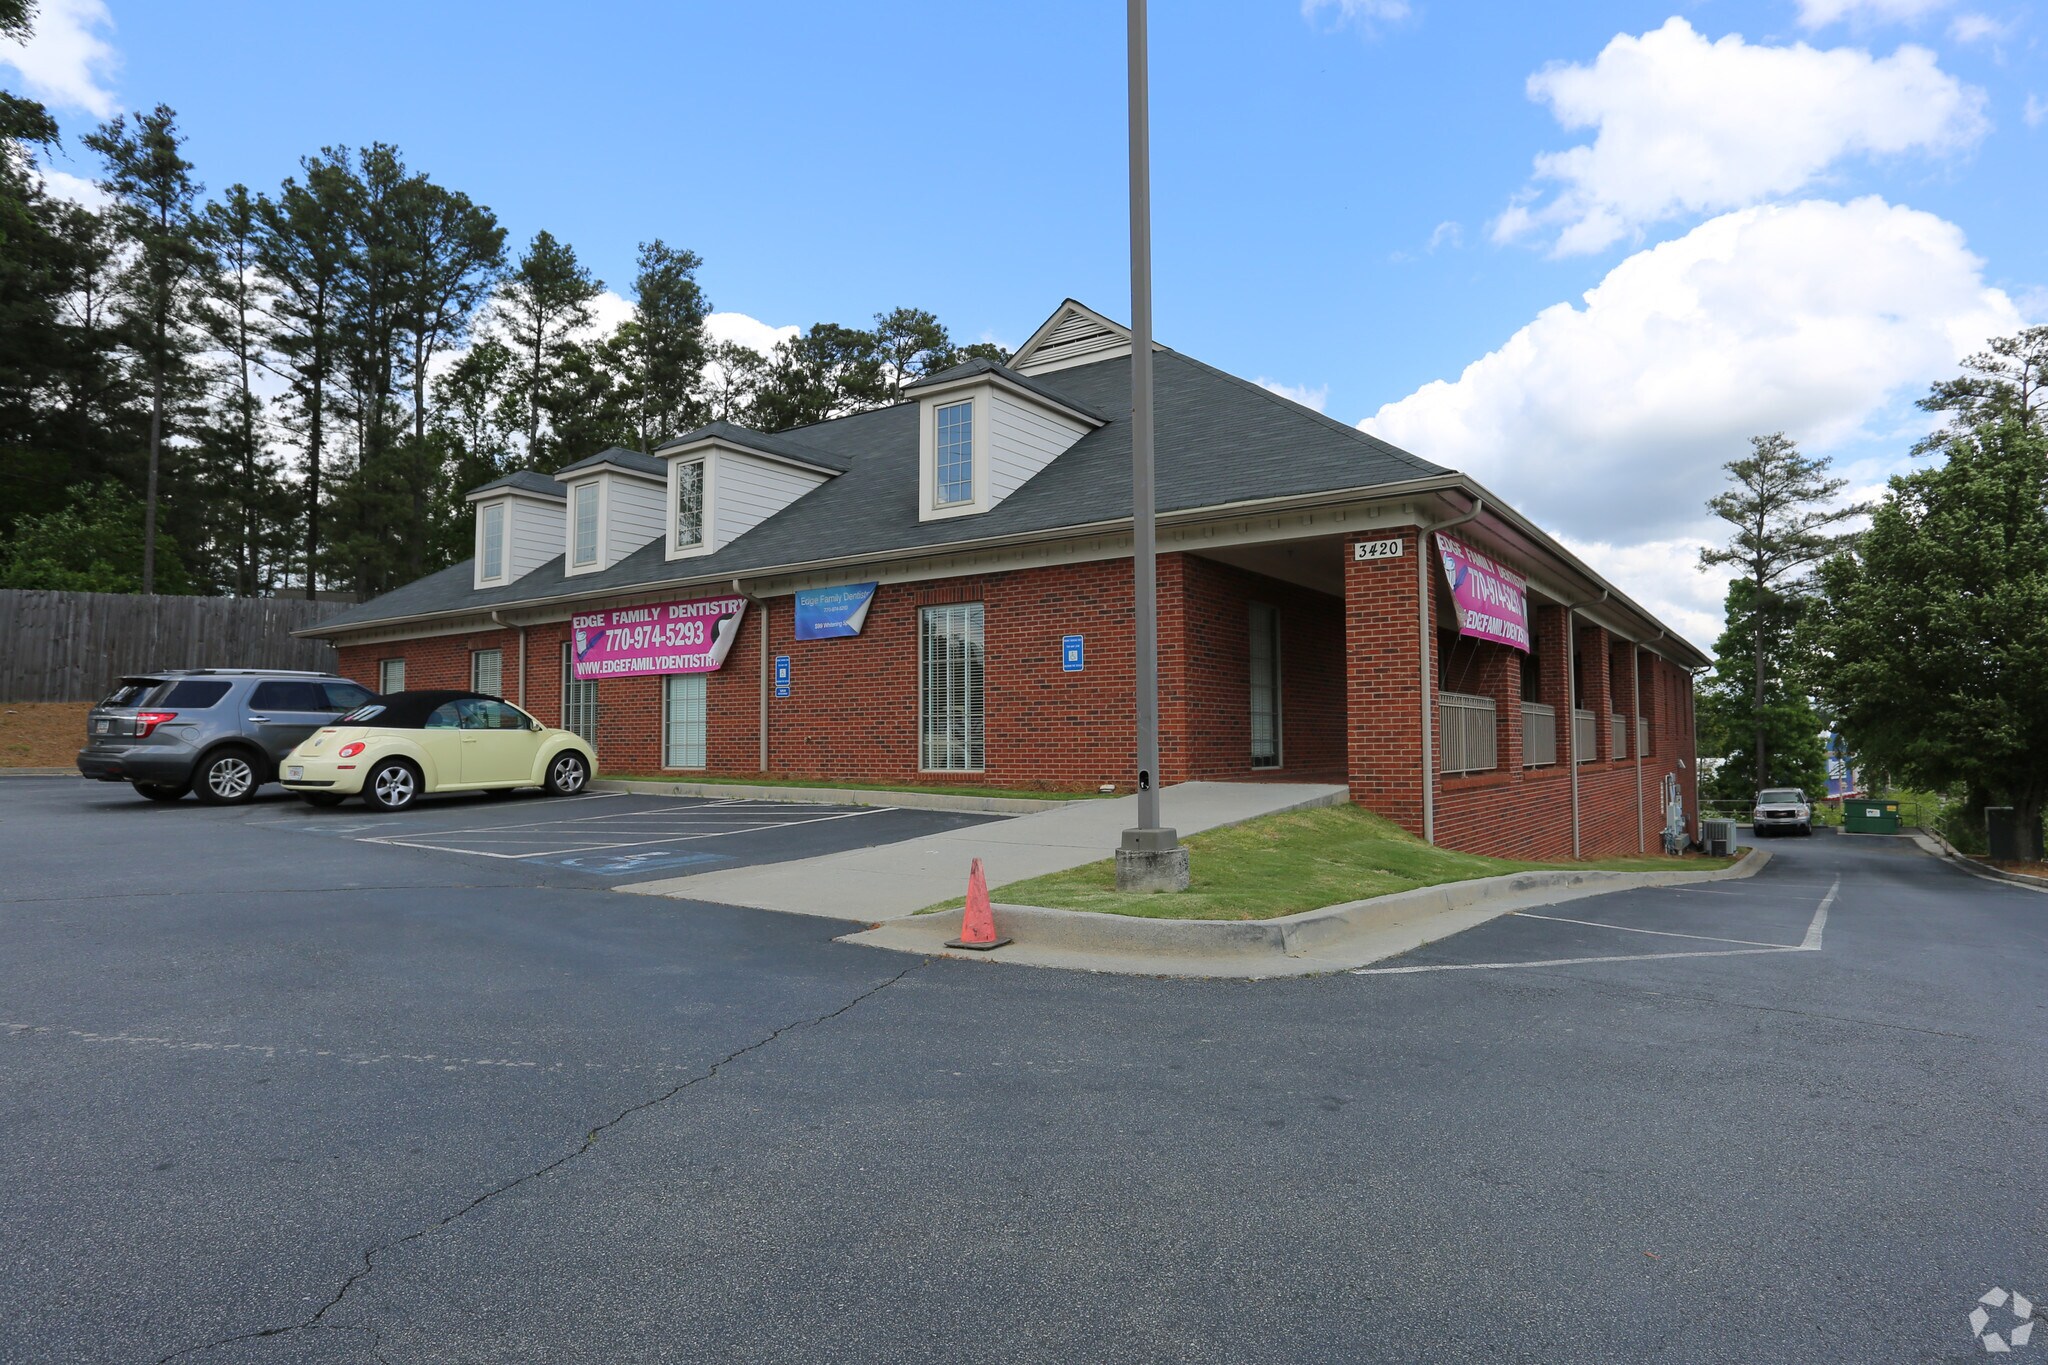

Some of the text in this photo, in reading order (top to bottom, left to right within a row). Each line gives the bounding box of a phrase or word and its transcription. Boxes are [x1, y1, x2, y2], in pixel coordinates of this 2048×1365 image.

[1359, 541, 1398, 558] 3420
[1436, 532, 1464, 559] EDGE
[1464, 547, 1496, 574] FAMILY
[801, 590, 870, 606] Edge Family Dentistr
[573, 599, 746, 629] EDGE FAMILY DENTISTRY
[606, 620, 704, 652] 770-974-5293
